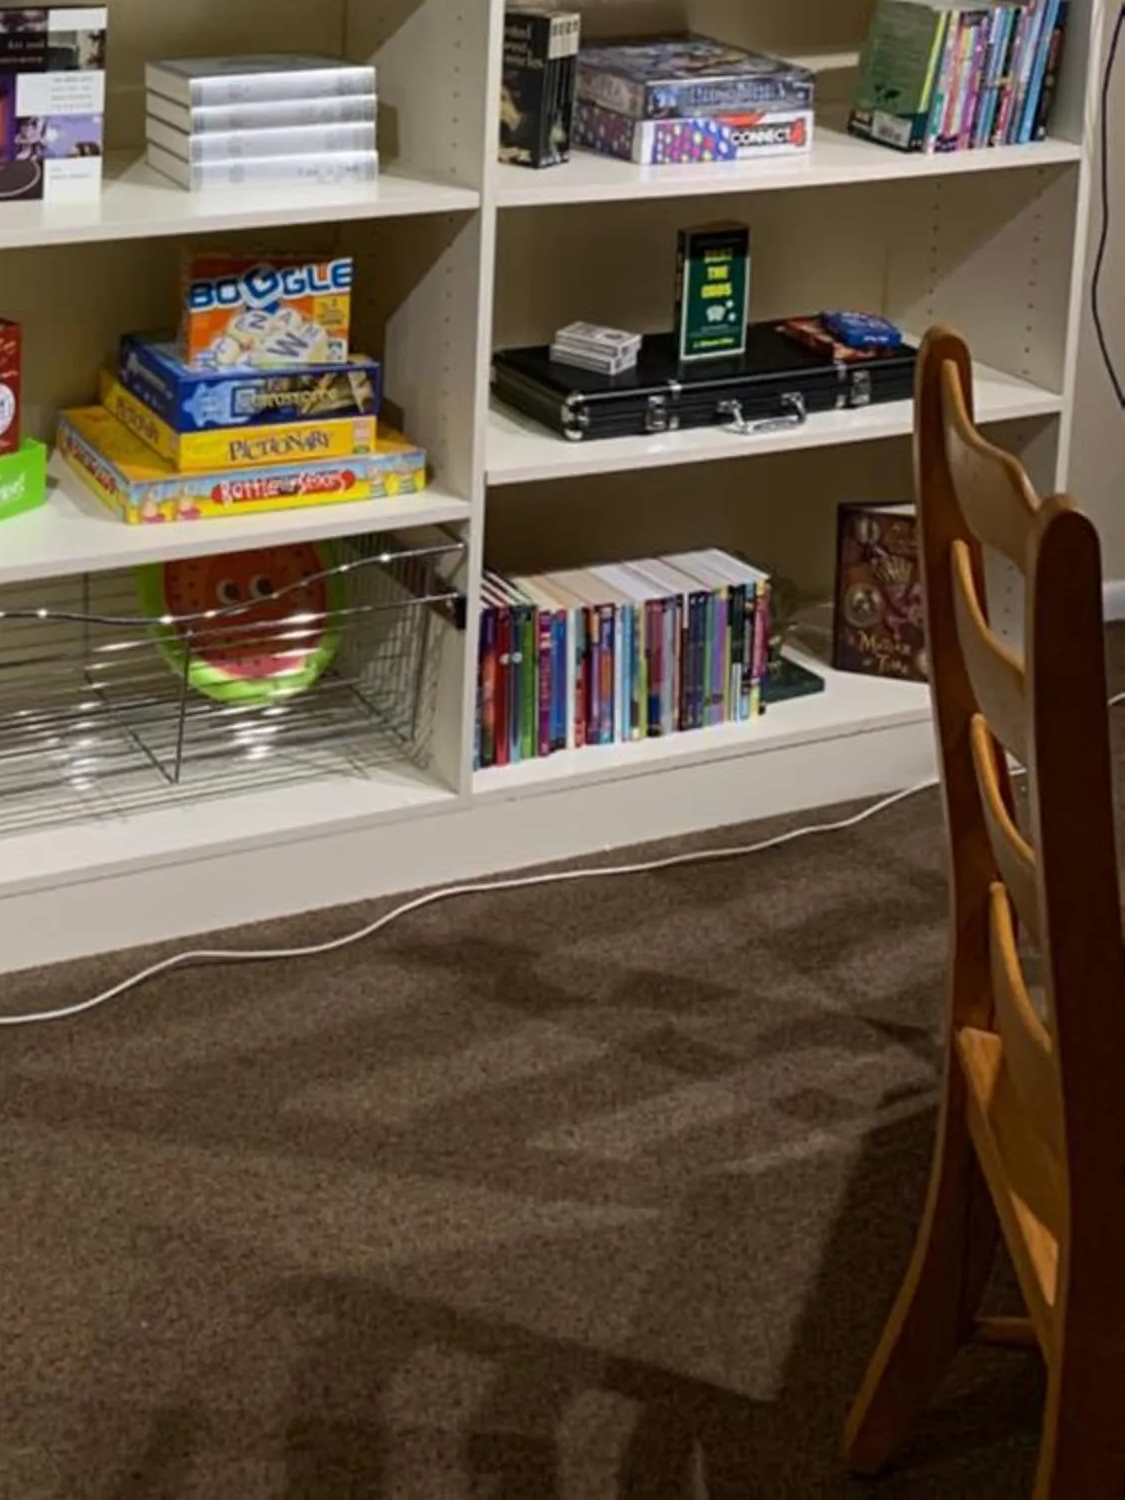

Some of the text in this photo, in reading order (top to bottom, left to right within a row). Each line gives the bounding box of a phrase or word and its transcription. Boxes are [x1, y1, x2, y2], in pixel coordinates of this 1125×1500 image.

[788, 116, 808, 148] 4
[188, 258, 353, 312] BOGGLE
[229, 430, 333, 462] PICTIONARY
